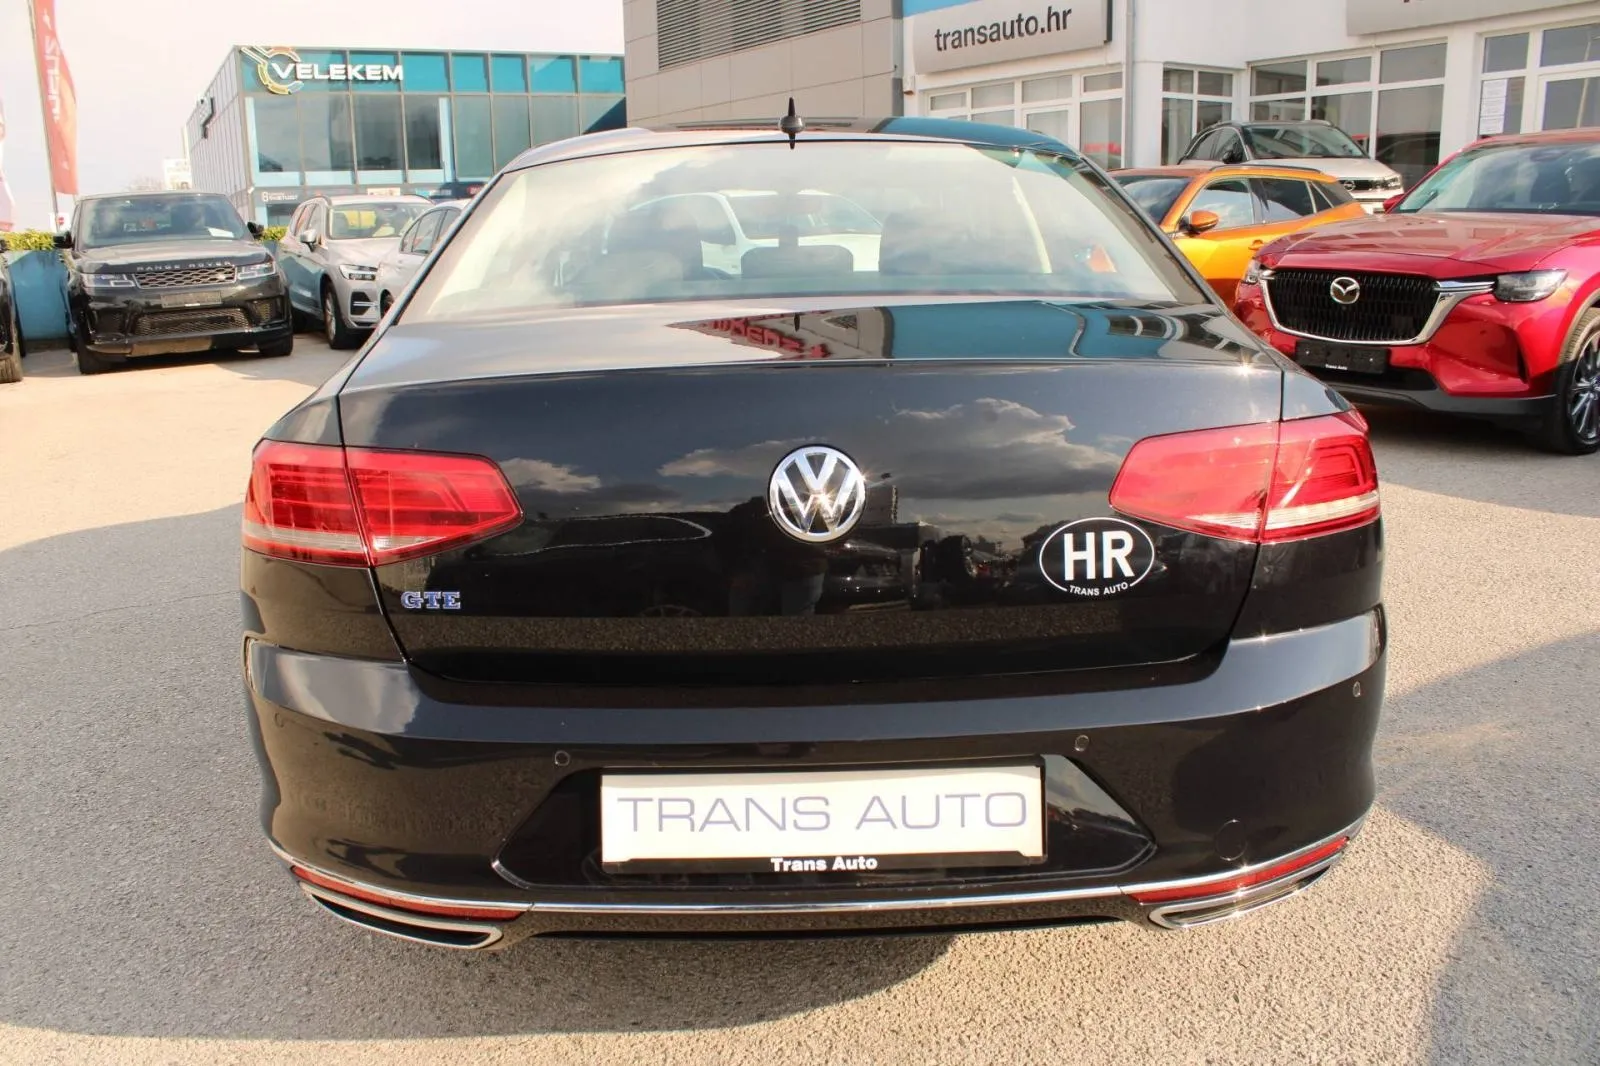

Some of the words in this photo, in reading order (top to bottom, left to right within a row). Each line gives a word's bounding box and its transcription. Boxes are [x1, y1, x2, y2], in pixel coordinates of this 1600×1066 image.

[934, 6, 1072, 51] transauto.hr
[271, 62, 404, 81] VELEKEM
[1063, 530, 1135, 581] HR
[1069, 584, 1100, 596] TRANS
[1103, 582, 1128, 595] AUTO
[400, 591, 461, 609] GTE
[617, 796, 831, 832] TRANS
[855, 792, 1027, 830] AUTO
[770, 857, 827, 872] Trans
[832, 856, 878, 871] Auto
